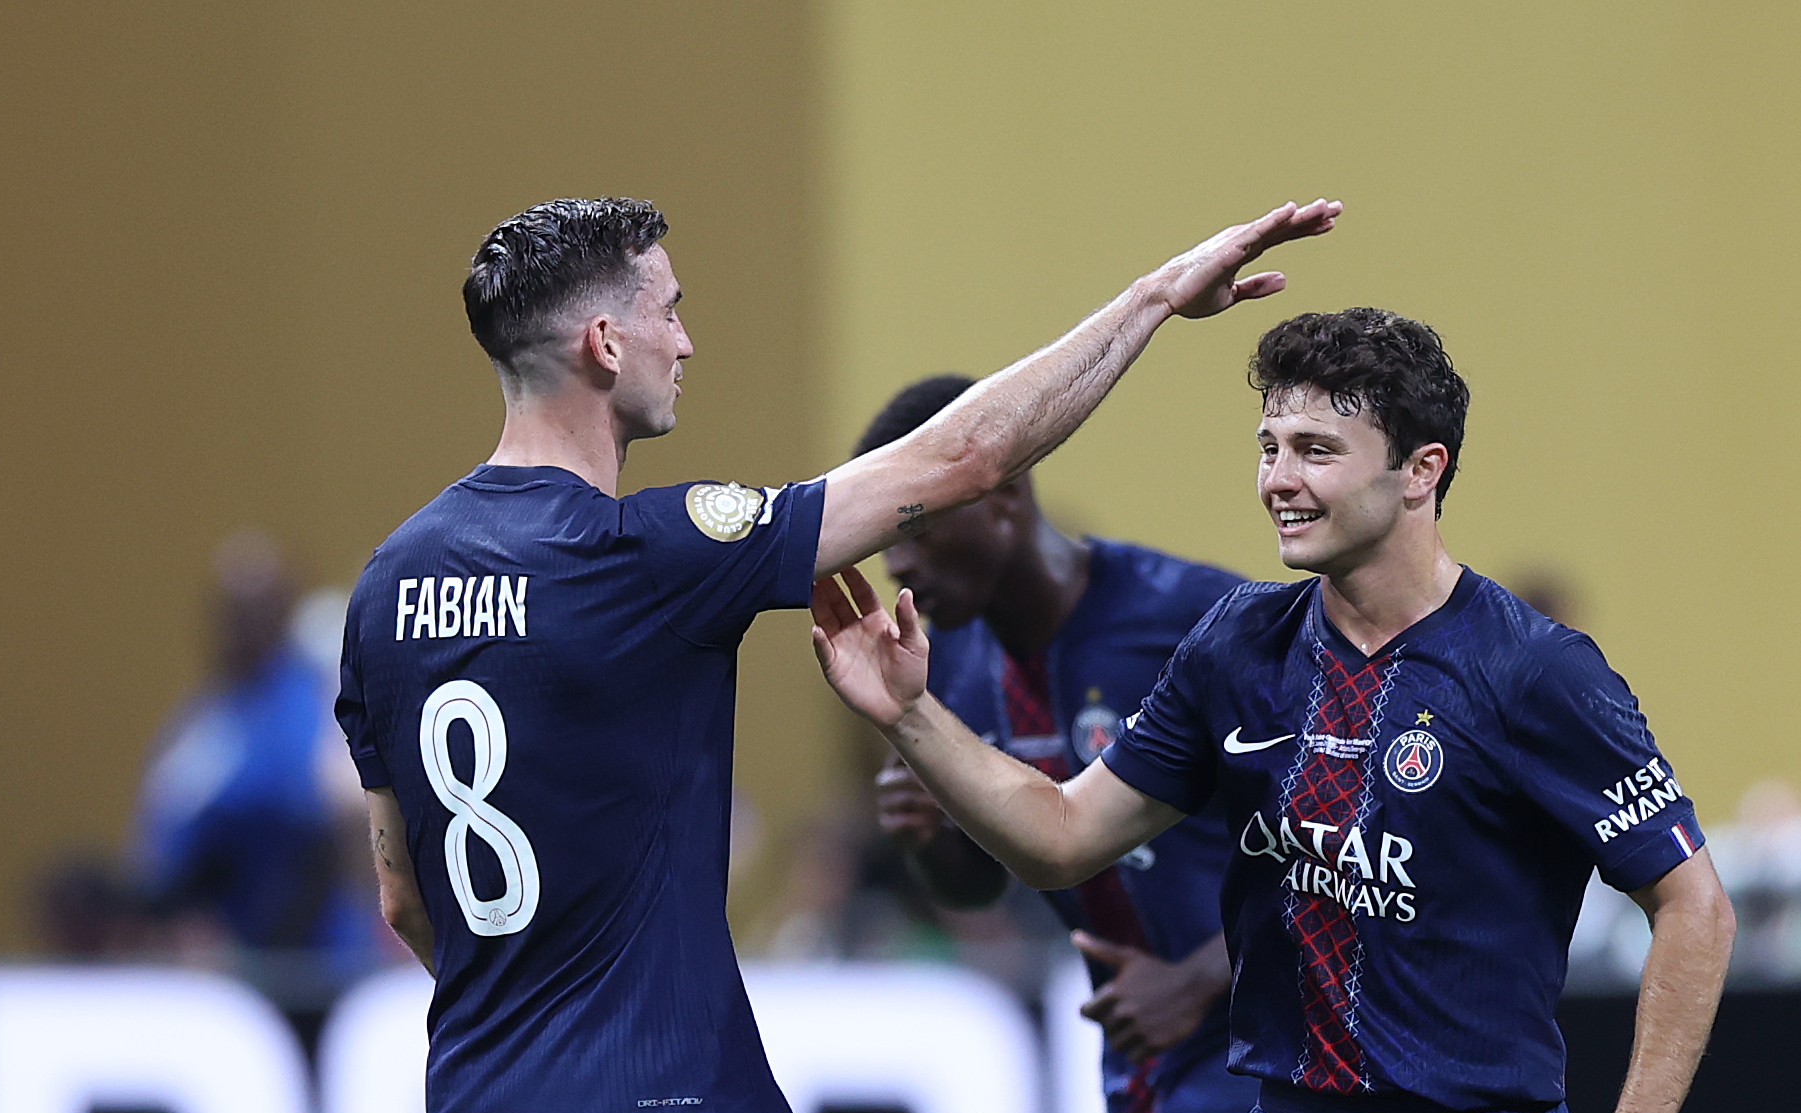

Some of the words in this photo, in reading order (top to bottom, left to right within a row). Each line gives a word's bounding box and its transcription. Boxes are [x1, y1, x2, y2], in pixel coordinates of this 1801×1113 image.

[693, 496, 715, 529] WORLD
[395, 575, 528, 641] FABIAN
[1399, 733, 1436, 751] PARIS
[420, 679, 540, 936] 8
[1602, 757, 1667, 805] VISIT
[1240, 810, 1417, 889] QATAR
[1280, 859, 1417, 922] AIRWAYS
